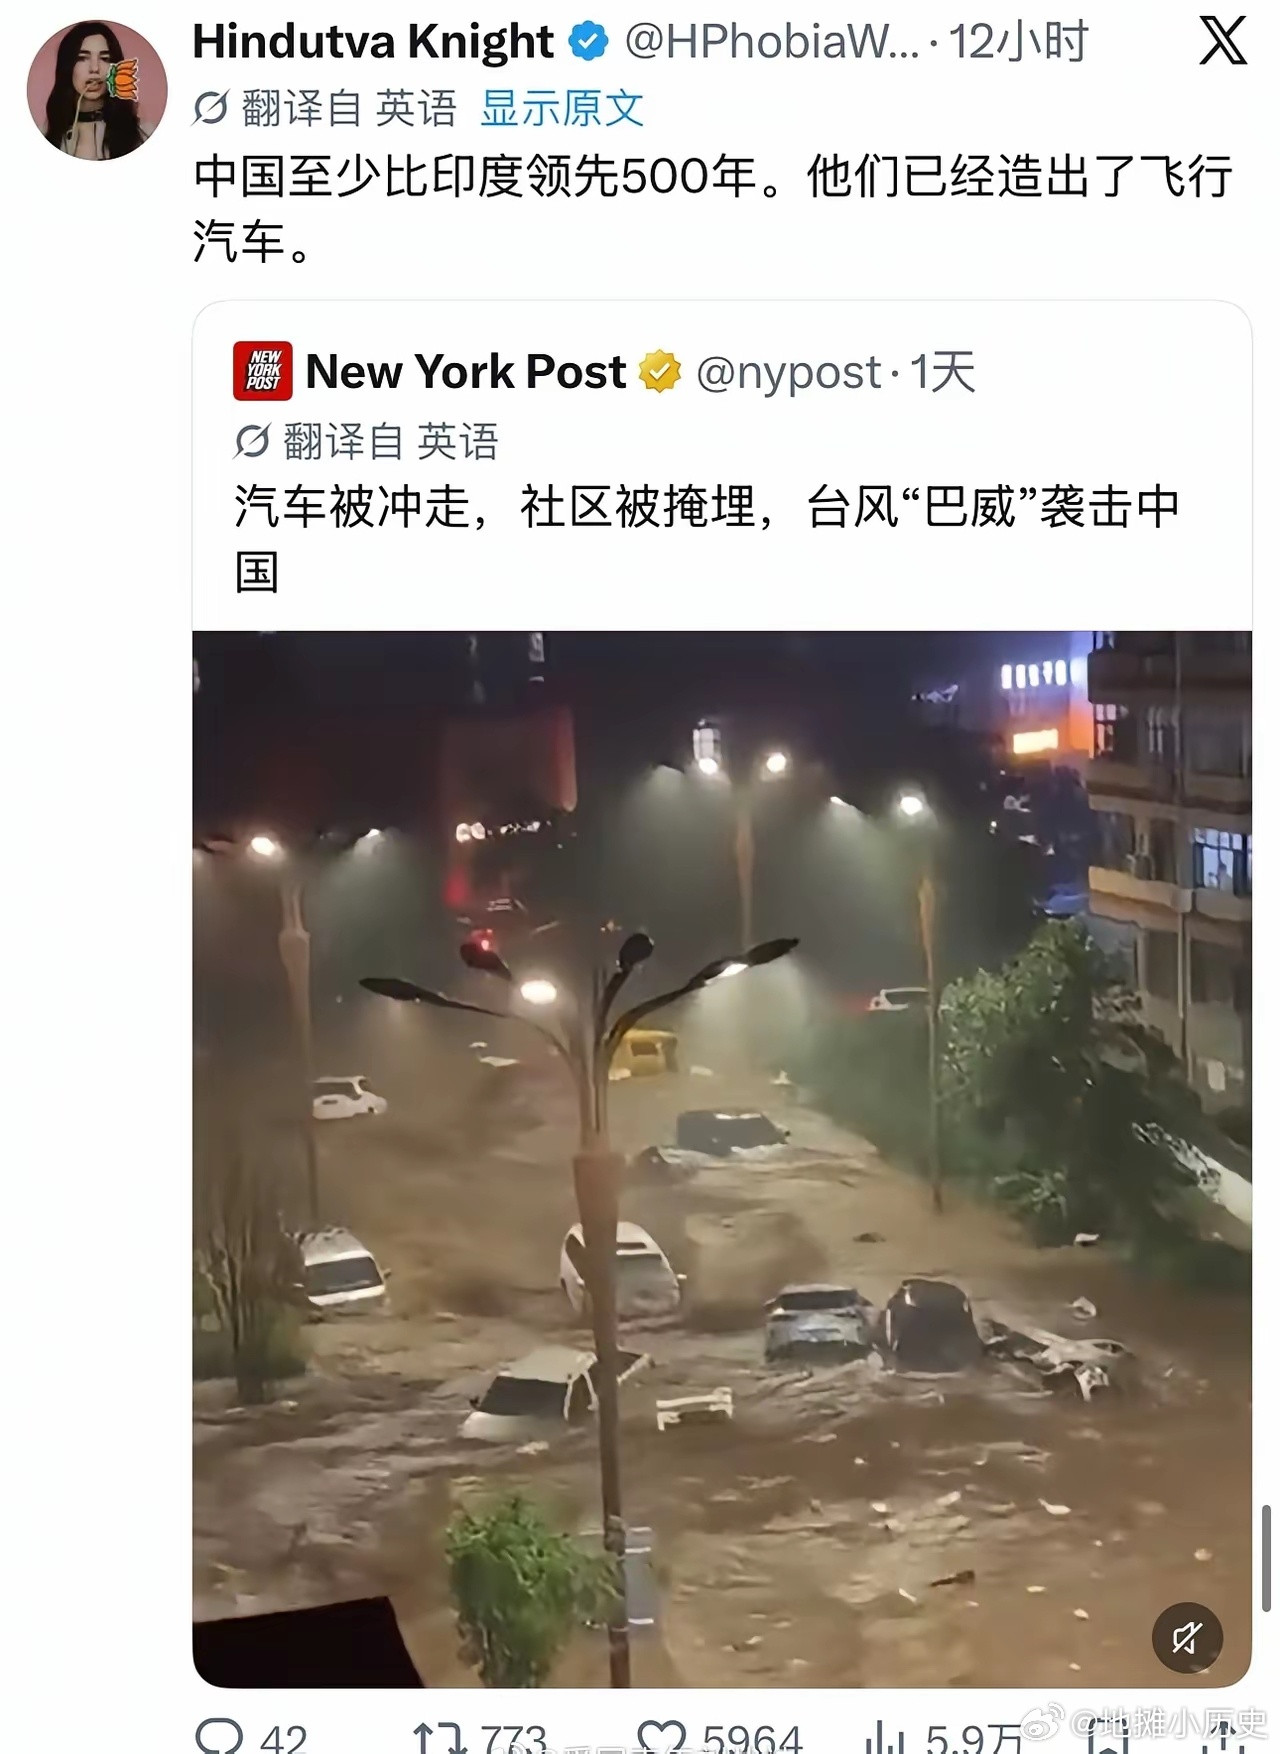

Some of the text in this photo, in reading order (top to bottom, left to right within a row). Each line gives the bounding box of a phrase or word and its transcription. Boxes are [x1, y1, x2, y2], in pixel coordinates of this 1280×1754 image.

[193, 21, 555, 69] Hindutva Knight
[626, 21, 919, 60] @HPhobiaW...
[949, 18, 1090, 63] 12小时
[242, 88, 457, 128] 翻译自 英语
[480, 88, 644, 128] 显示原文
[194, 152, 1233, 199] 中国至少比印度领先500年。他们已经造出了飞行
[193, 218, 306, 264] 汽车。
[247, 363, 282, 377] YORK
[250, 350, 282, 363] NEW
[307, 351, 627, 390] New York Post
[911, 350, 976, 393] 1天
[246, 376, 281, 390] POST
[697, 355, 882, 399] @nypost
[283, 421, 499, 461] 翻译自 英语
[236, 550, 278, 594] 国
[260, 1725, 307, 1754] 42
[481, 1725, 547, 1754] 773
[702, 1725, 804, 1754] 5964
